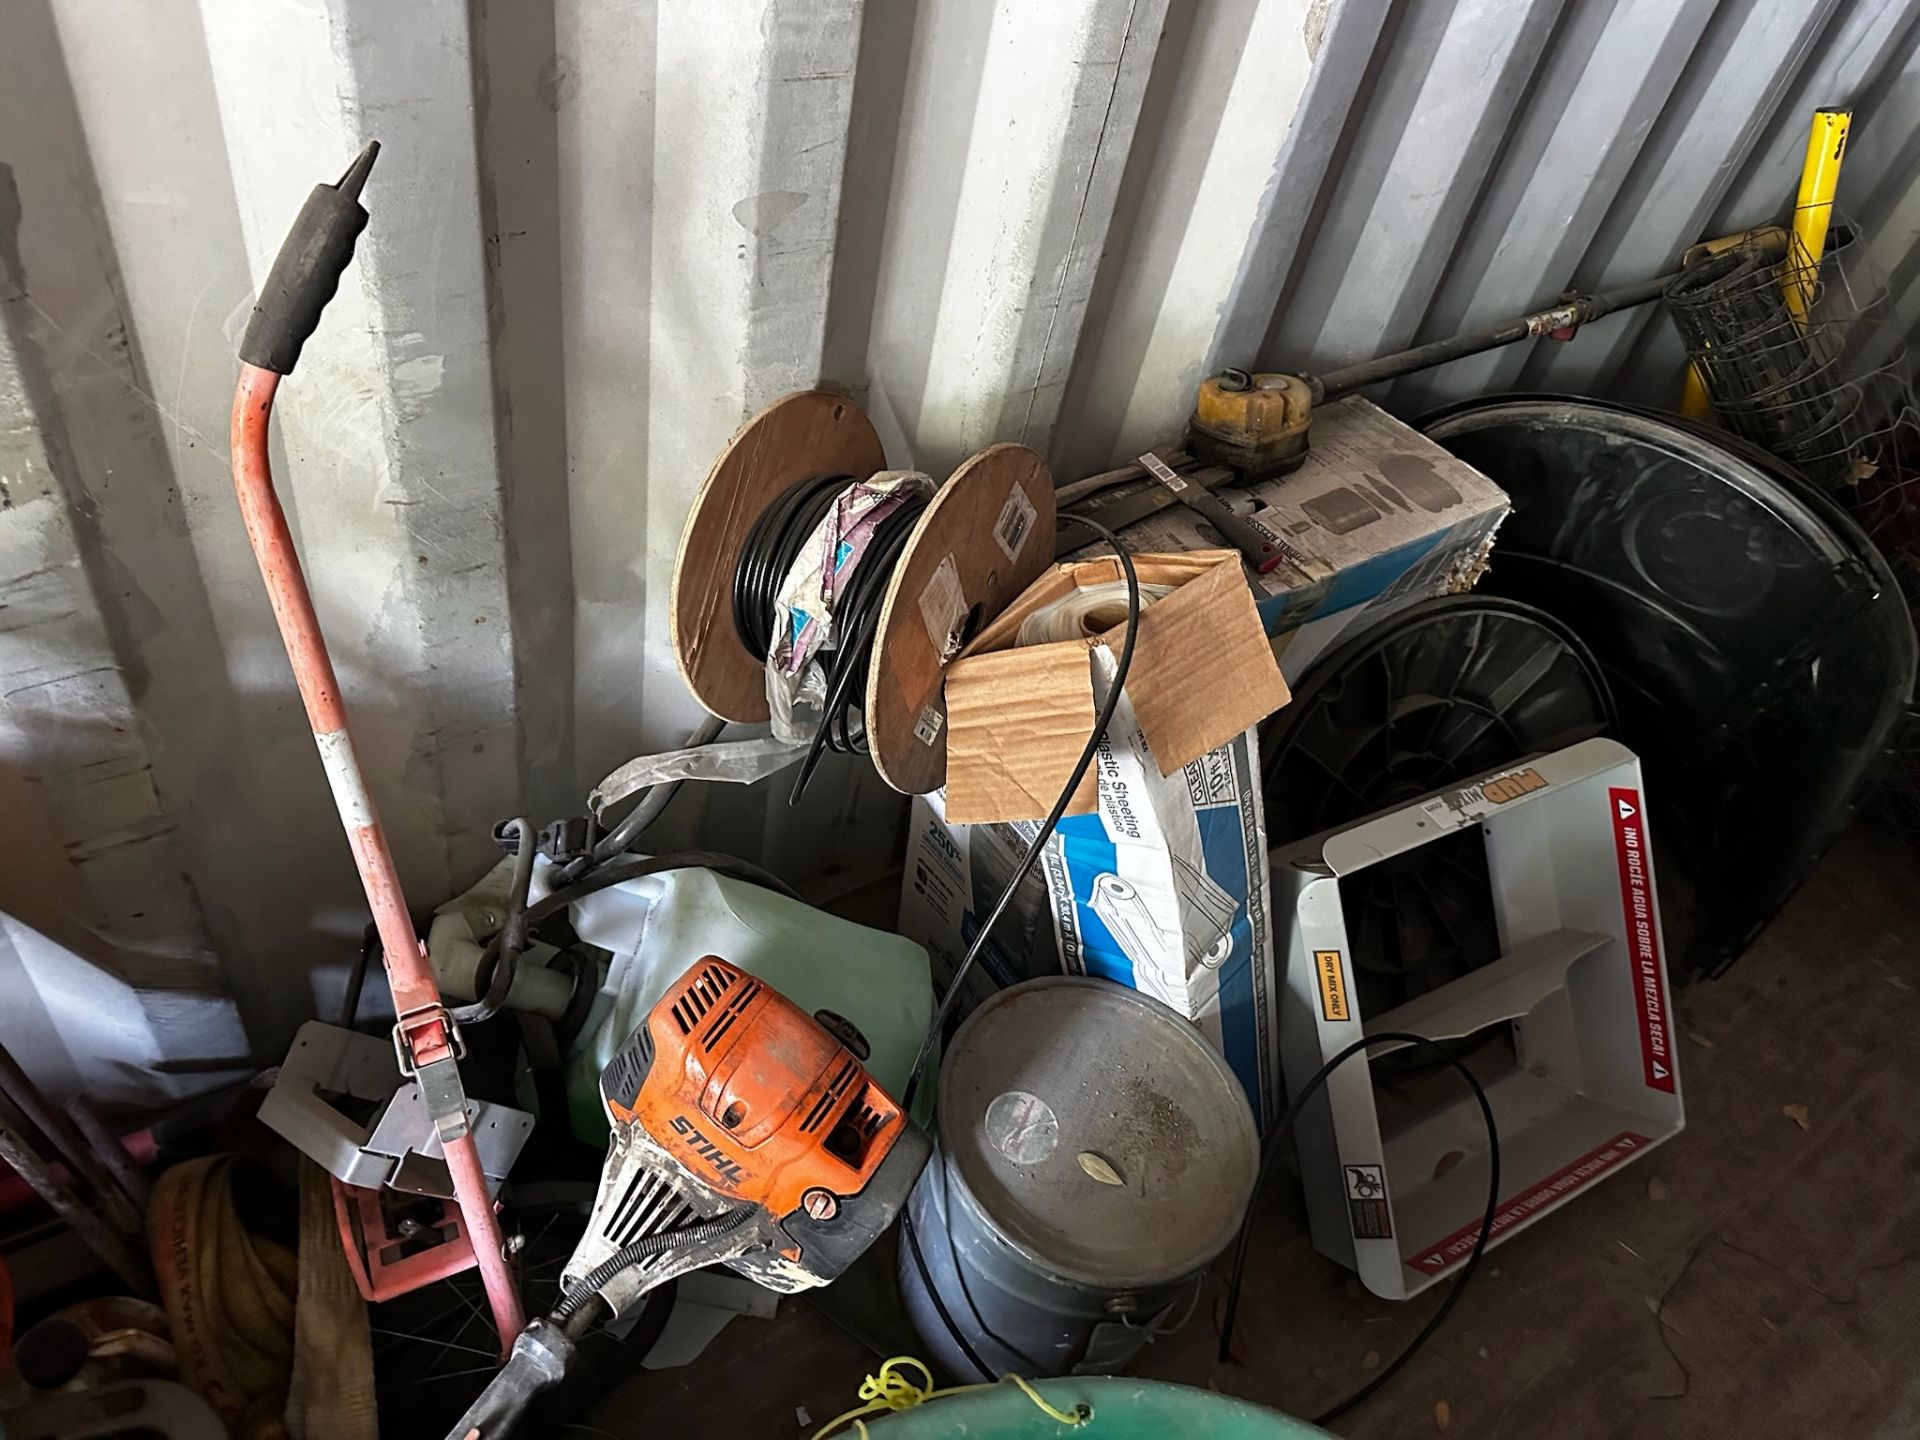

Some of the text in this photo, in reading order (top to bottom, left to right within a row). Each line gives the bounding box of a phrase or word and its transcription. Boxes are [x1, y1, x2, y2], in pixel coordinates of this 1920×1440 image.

[1099, 778, 1125, 833] de plástico
[1111, 781, 1141, 839] Sheeting
[1481, 767, 1549, 805] MUD
[929, 820, 962, 862] 250%
[1065, 931, 1076, 942] X
[1624, 826, 1665, 1057] ¡NO ROCÍE AGUA SOBRE LA MEZCLA SECA!
[1324, 956, 1341, 1016] DRY MIX ONLY
[668, 1115, 743, 1185] STIHL
